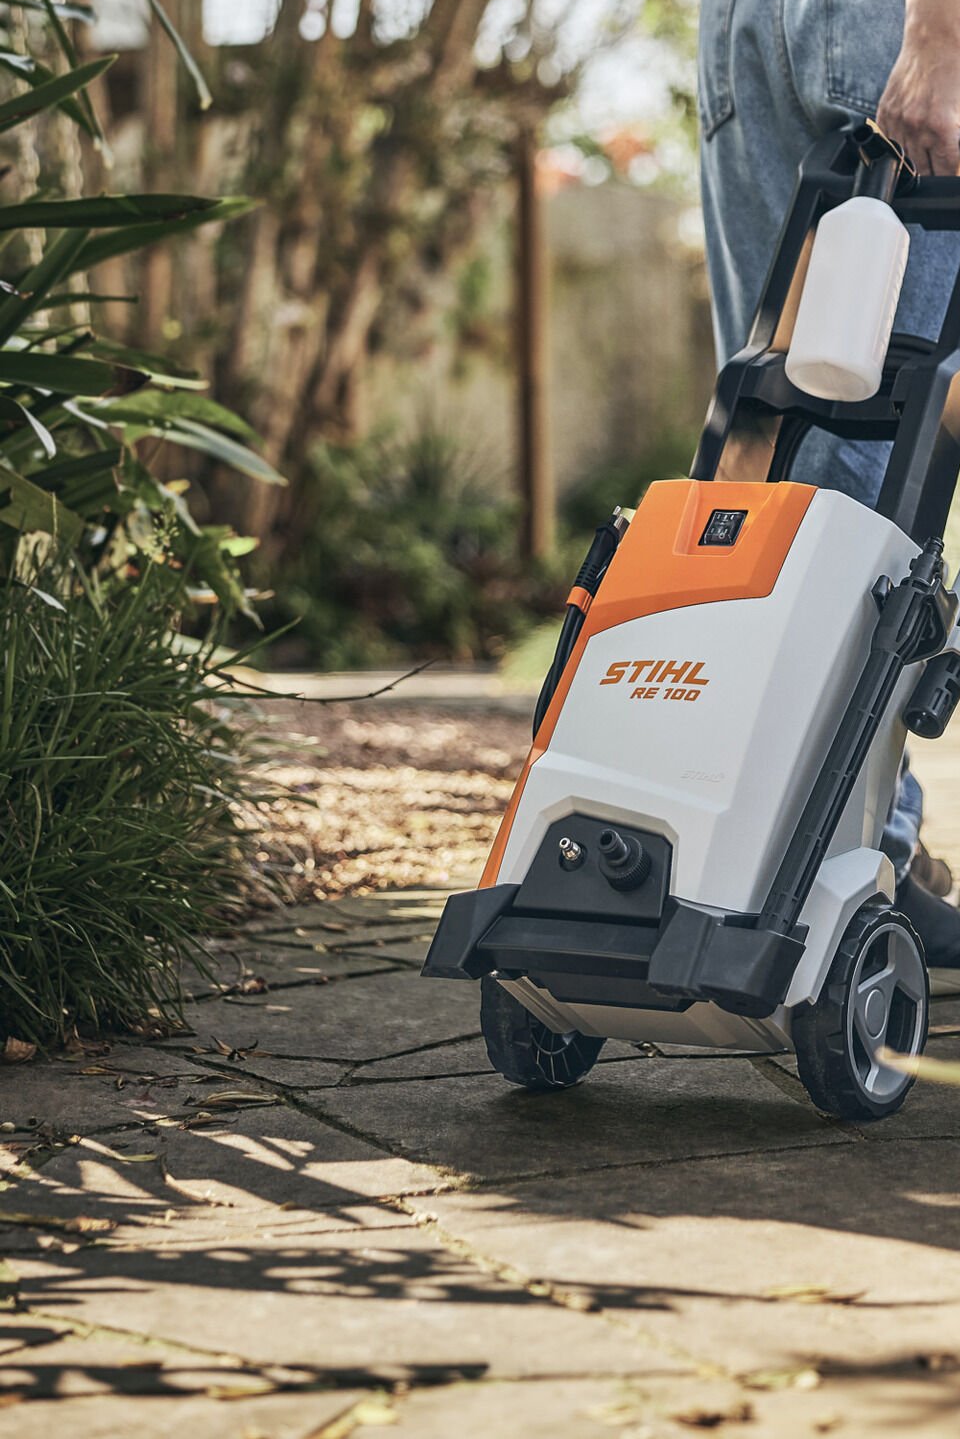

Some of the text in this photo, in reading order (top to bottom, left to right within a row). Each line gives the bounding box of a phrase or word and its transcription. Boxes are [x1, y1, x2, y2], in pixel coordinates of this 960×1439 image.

[600, 660, 710, 686] STIHL
[630, 687, 701, 701] RE 100
